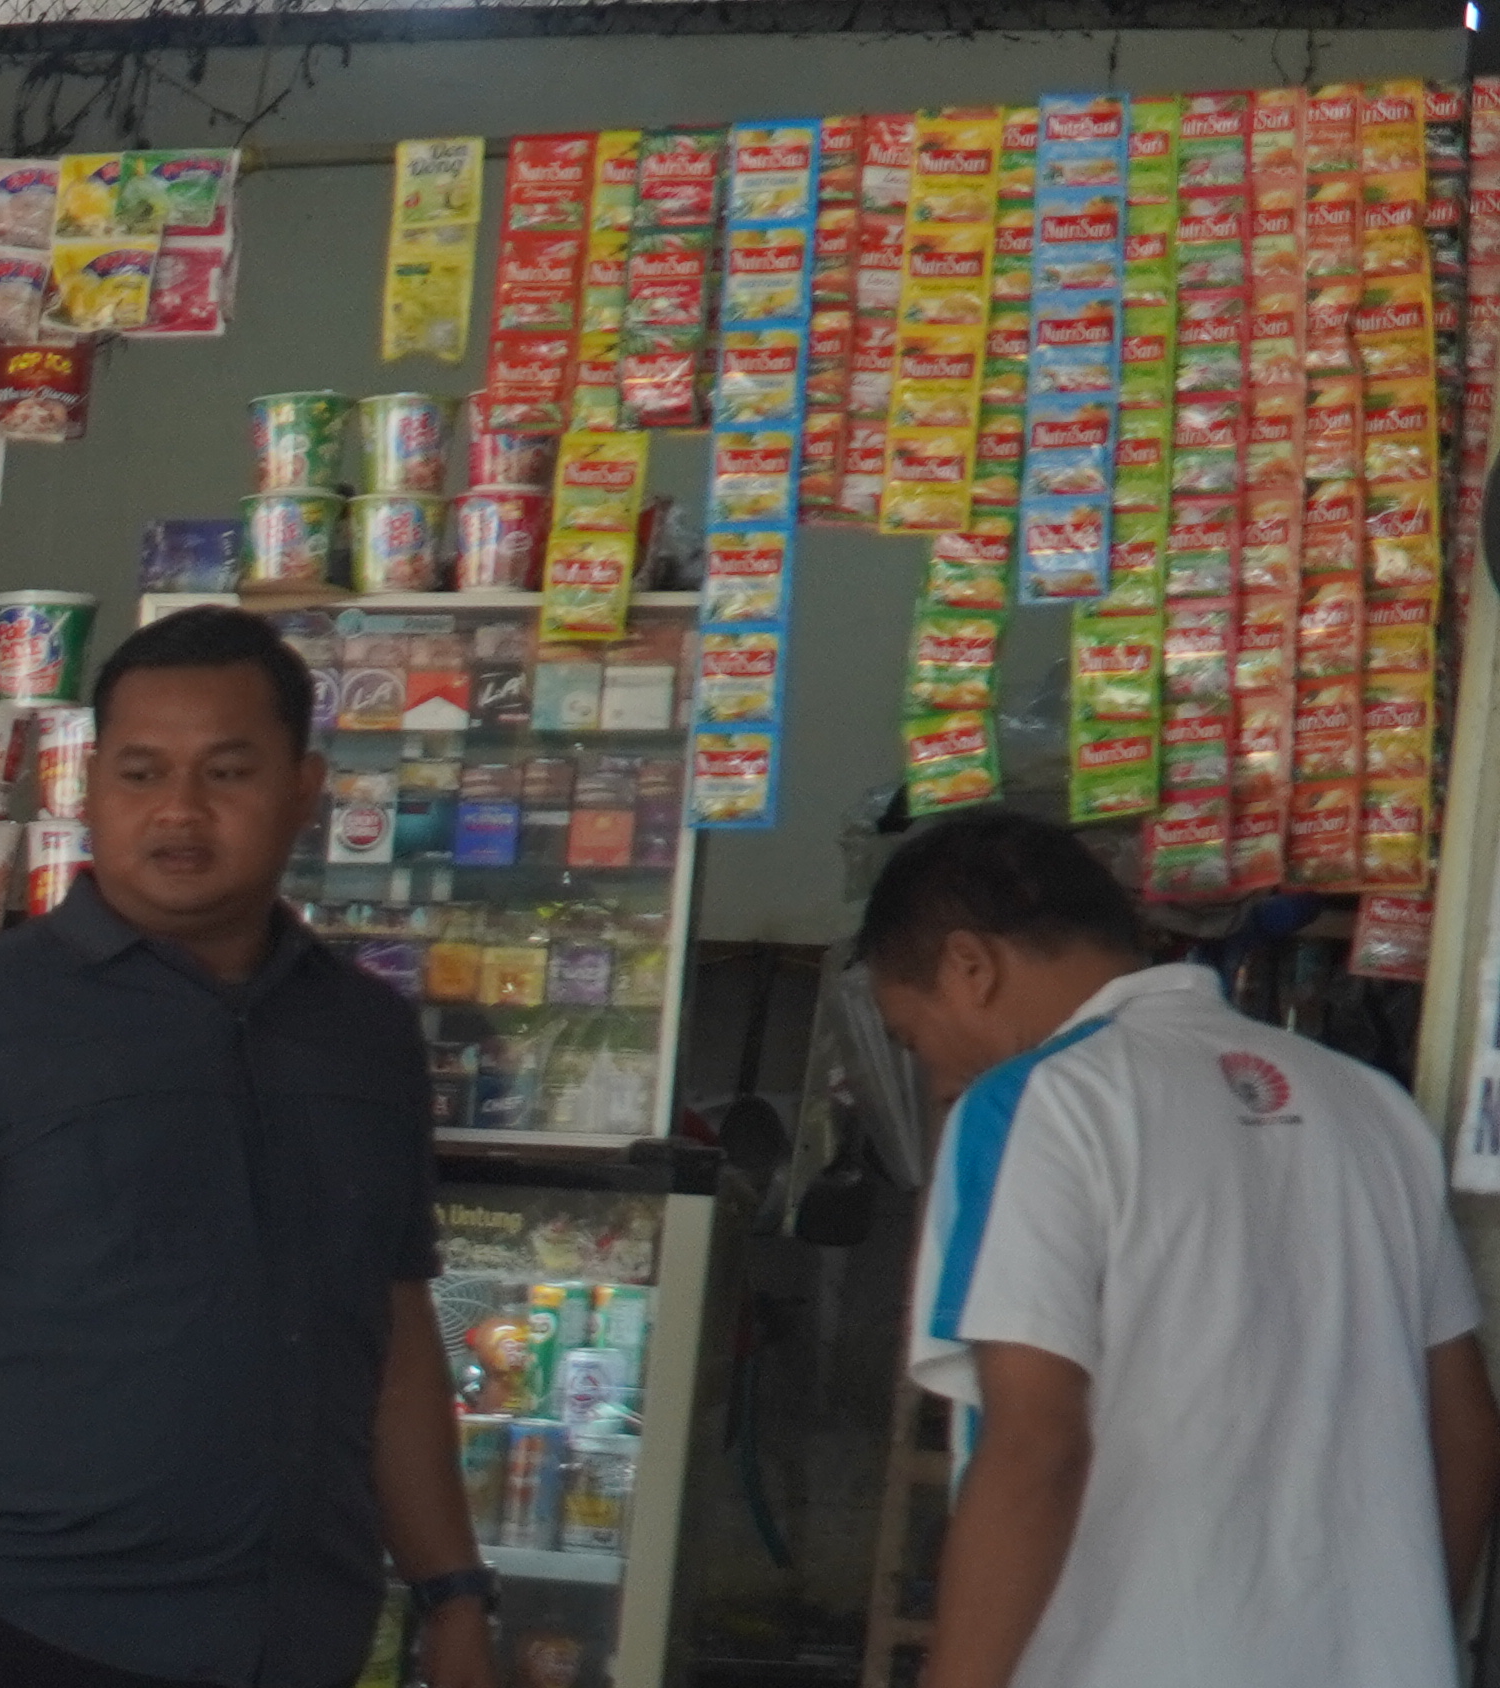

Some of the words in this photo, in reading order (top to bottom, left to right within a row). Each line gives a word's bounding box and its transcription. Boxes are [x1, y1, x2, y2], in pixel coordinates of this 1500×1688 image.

[1183, 115, 1241, 136] utriSari
[1179, 218, 1238, 240] utriSari
[1356, 305, 1420, 330] utriSari
